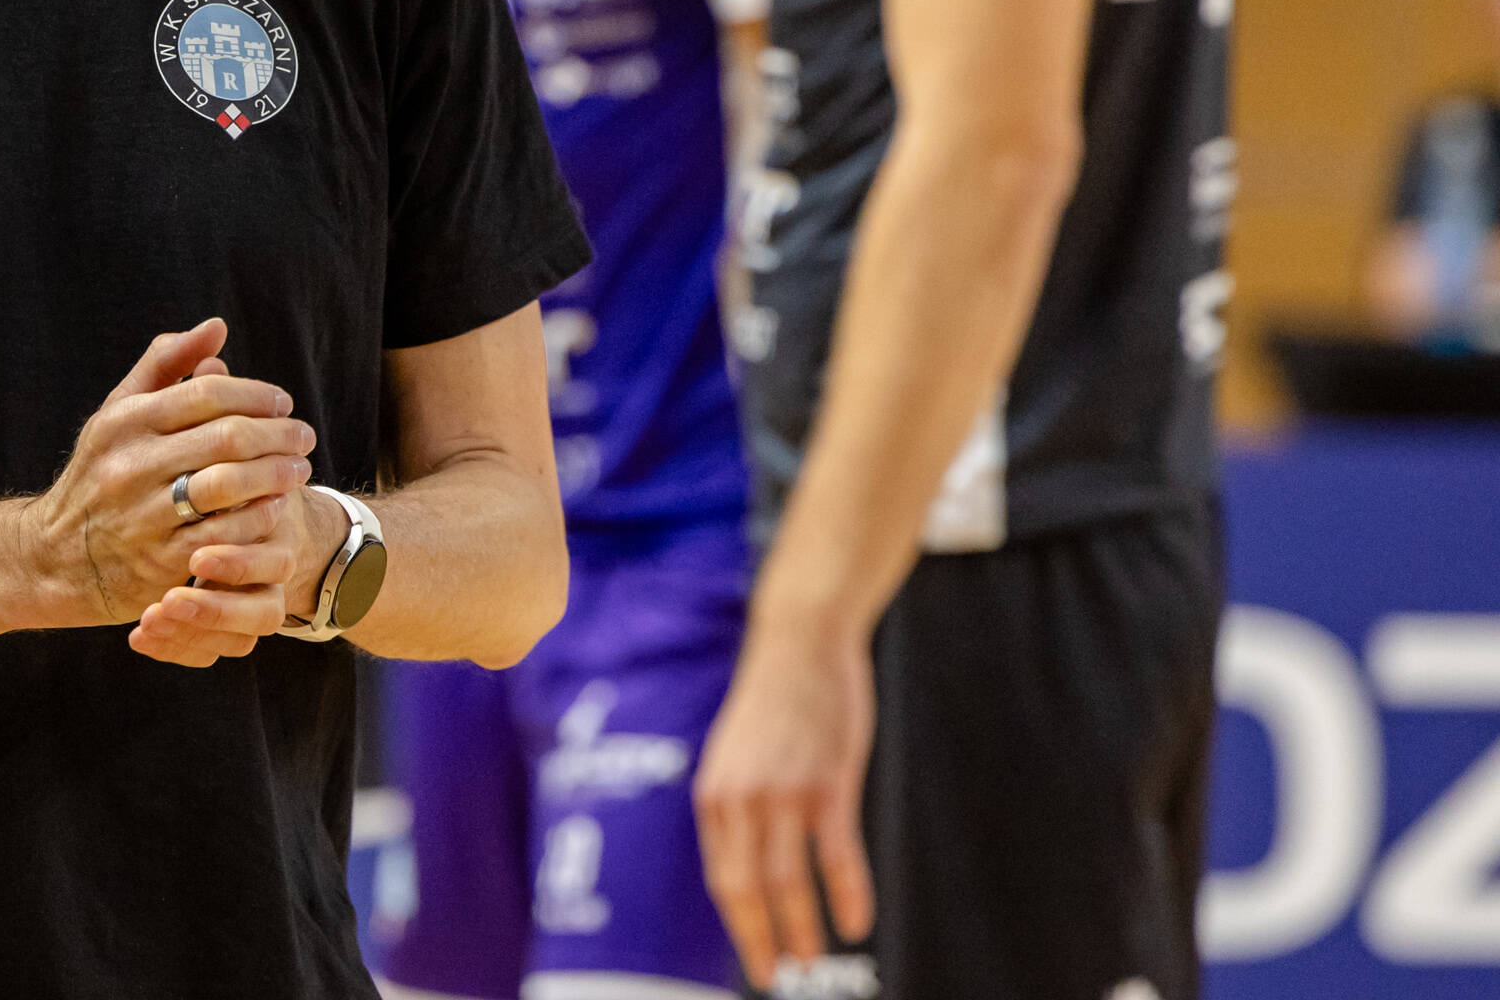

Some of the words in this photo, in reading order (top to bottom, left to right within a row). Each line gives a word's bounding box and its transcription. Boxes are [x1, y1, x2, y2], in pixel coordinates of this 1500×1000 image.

[222, 71, 239, 92] R
[185, 86, 209, 109] 19
[254, 93, 277, 117] 21
